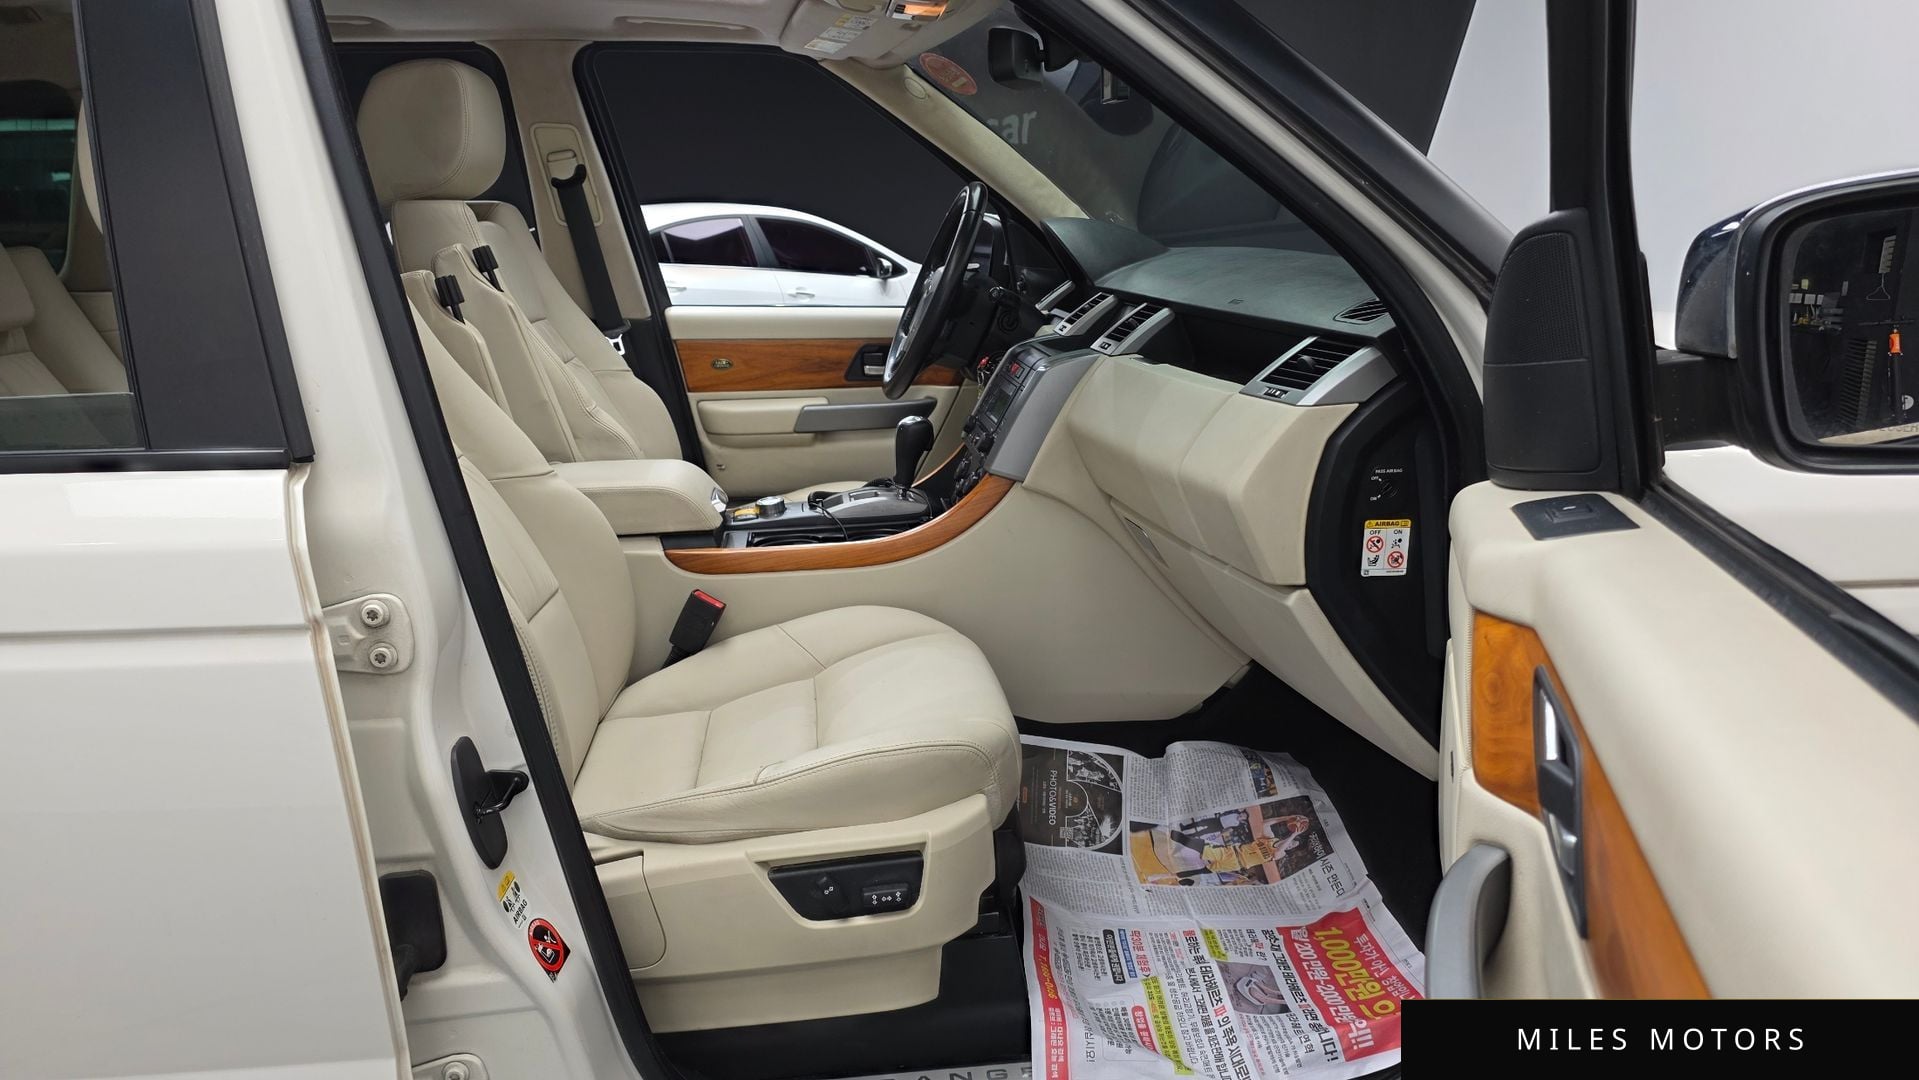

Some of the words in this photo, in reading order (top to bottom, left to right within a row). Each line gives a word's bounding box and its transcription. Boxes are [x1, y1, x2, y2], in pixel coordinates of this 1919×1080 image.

[1048, 770, 1057, 825] PHOTO&VIDEO
[1318, 857, 1333, 874] 시즌
[1326, 873, 1345, 898] 만든다
[512, 899, 527, 924] AIRBAG
[1352, 933, 1378, 961] 투자가
[1313, 928, 1385, 1001] 1,000만원
[1199, 964, 1223, 1007] 테라헤르츠
[1177, 1010, 1189, 1027] 하오니
[1193, 994, 1208, 1013] 그래핀
[1207, 1035, 1226, 1063] 제조판매
[1217, 1015, 1231, 1028] 의
[1221, 1025, 1239, 1047] 족욕
